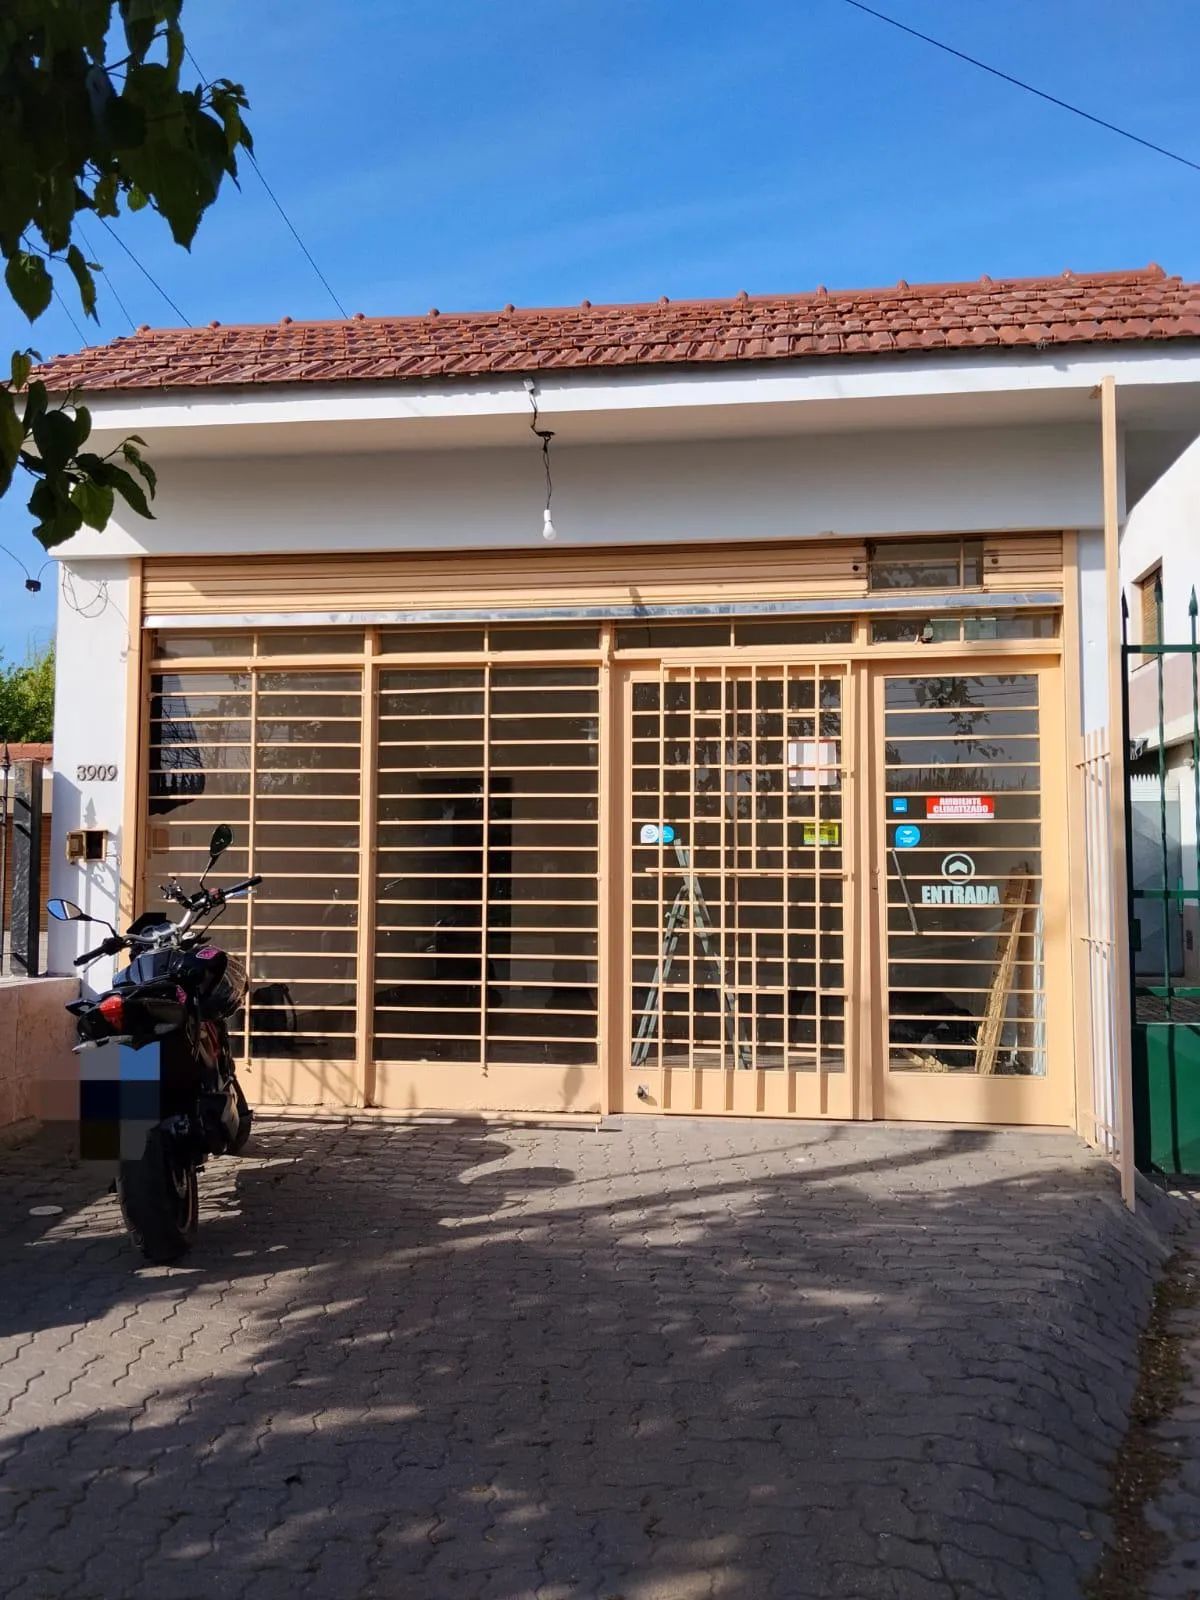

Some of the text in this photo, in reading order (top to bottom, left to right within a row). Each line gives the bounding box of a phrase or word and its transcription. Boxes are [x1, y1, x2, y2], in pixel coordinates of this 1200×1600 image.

[77, 765, 117, 781] 3909
[933, 805, 988, 813] CLIMATIZADO
[921, 885, 1000, 904] ENTRADA
